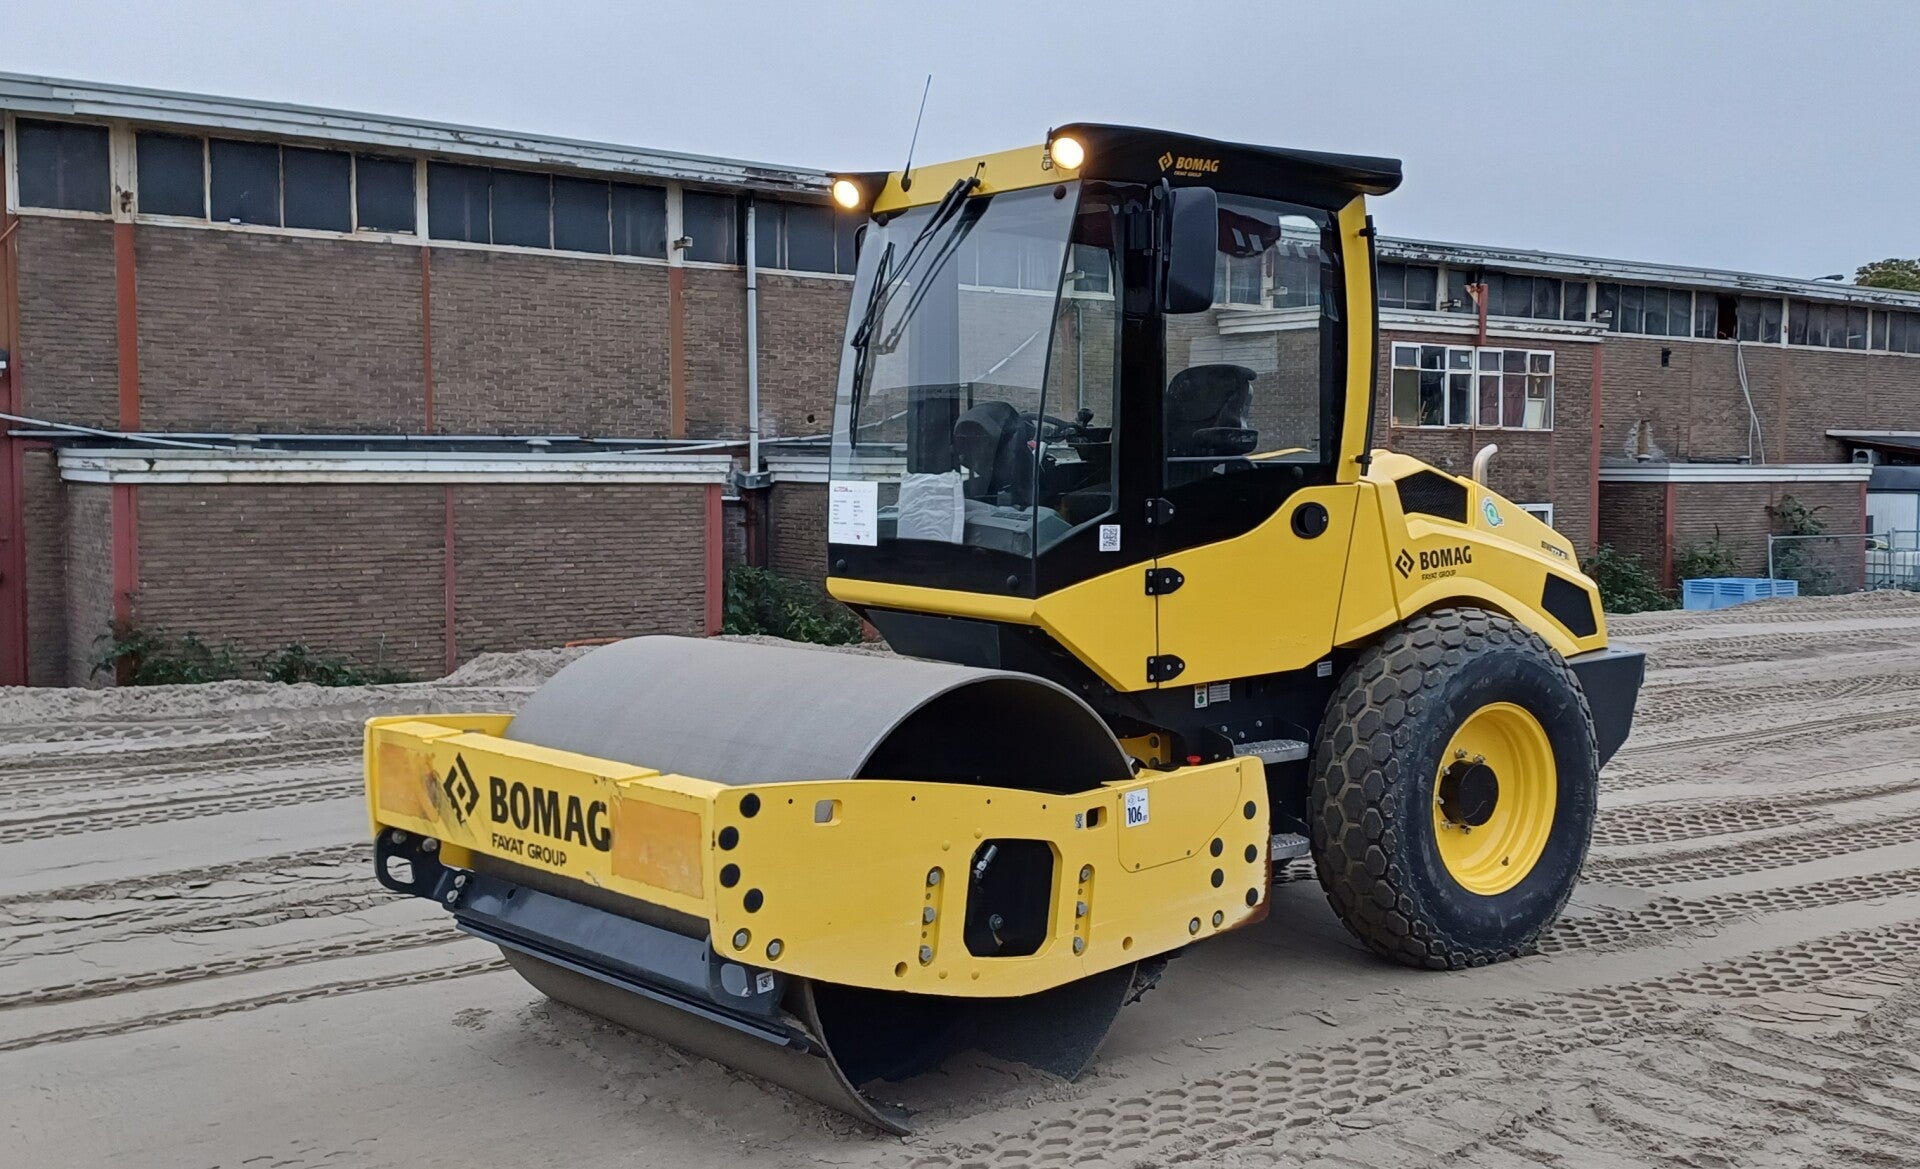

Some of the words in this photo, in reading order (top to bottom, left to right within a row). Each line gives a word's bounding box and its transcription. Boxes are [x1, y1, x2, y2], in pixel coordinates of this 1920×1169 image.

[1176, 157, 1220, 172] BOMAG
[1419, 545, 1472, 570] BOMAG
[489, 776, 612, 852] BOMAG
[1127, 805, 1142, 824] 106
[492, 832, 524, 855] FAYAT
[527, 843, 567, 867] GROUP
